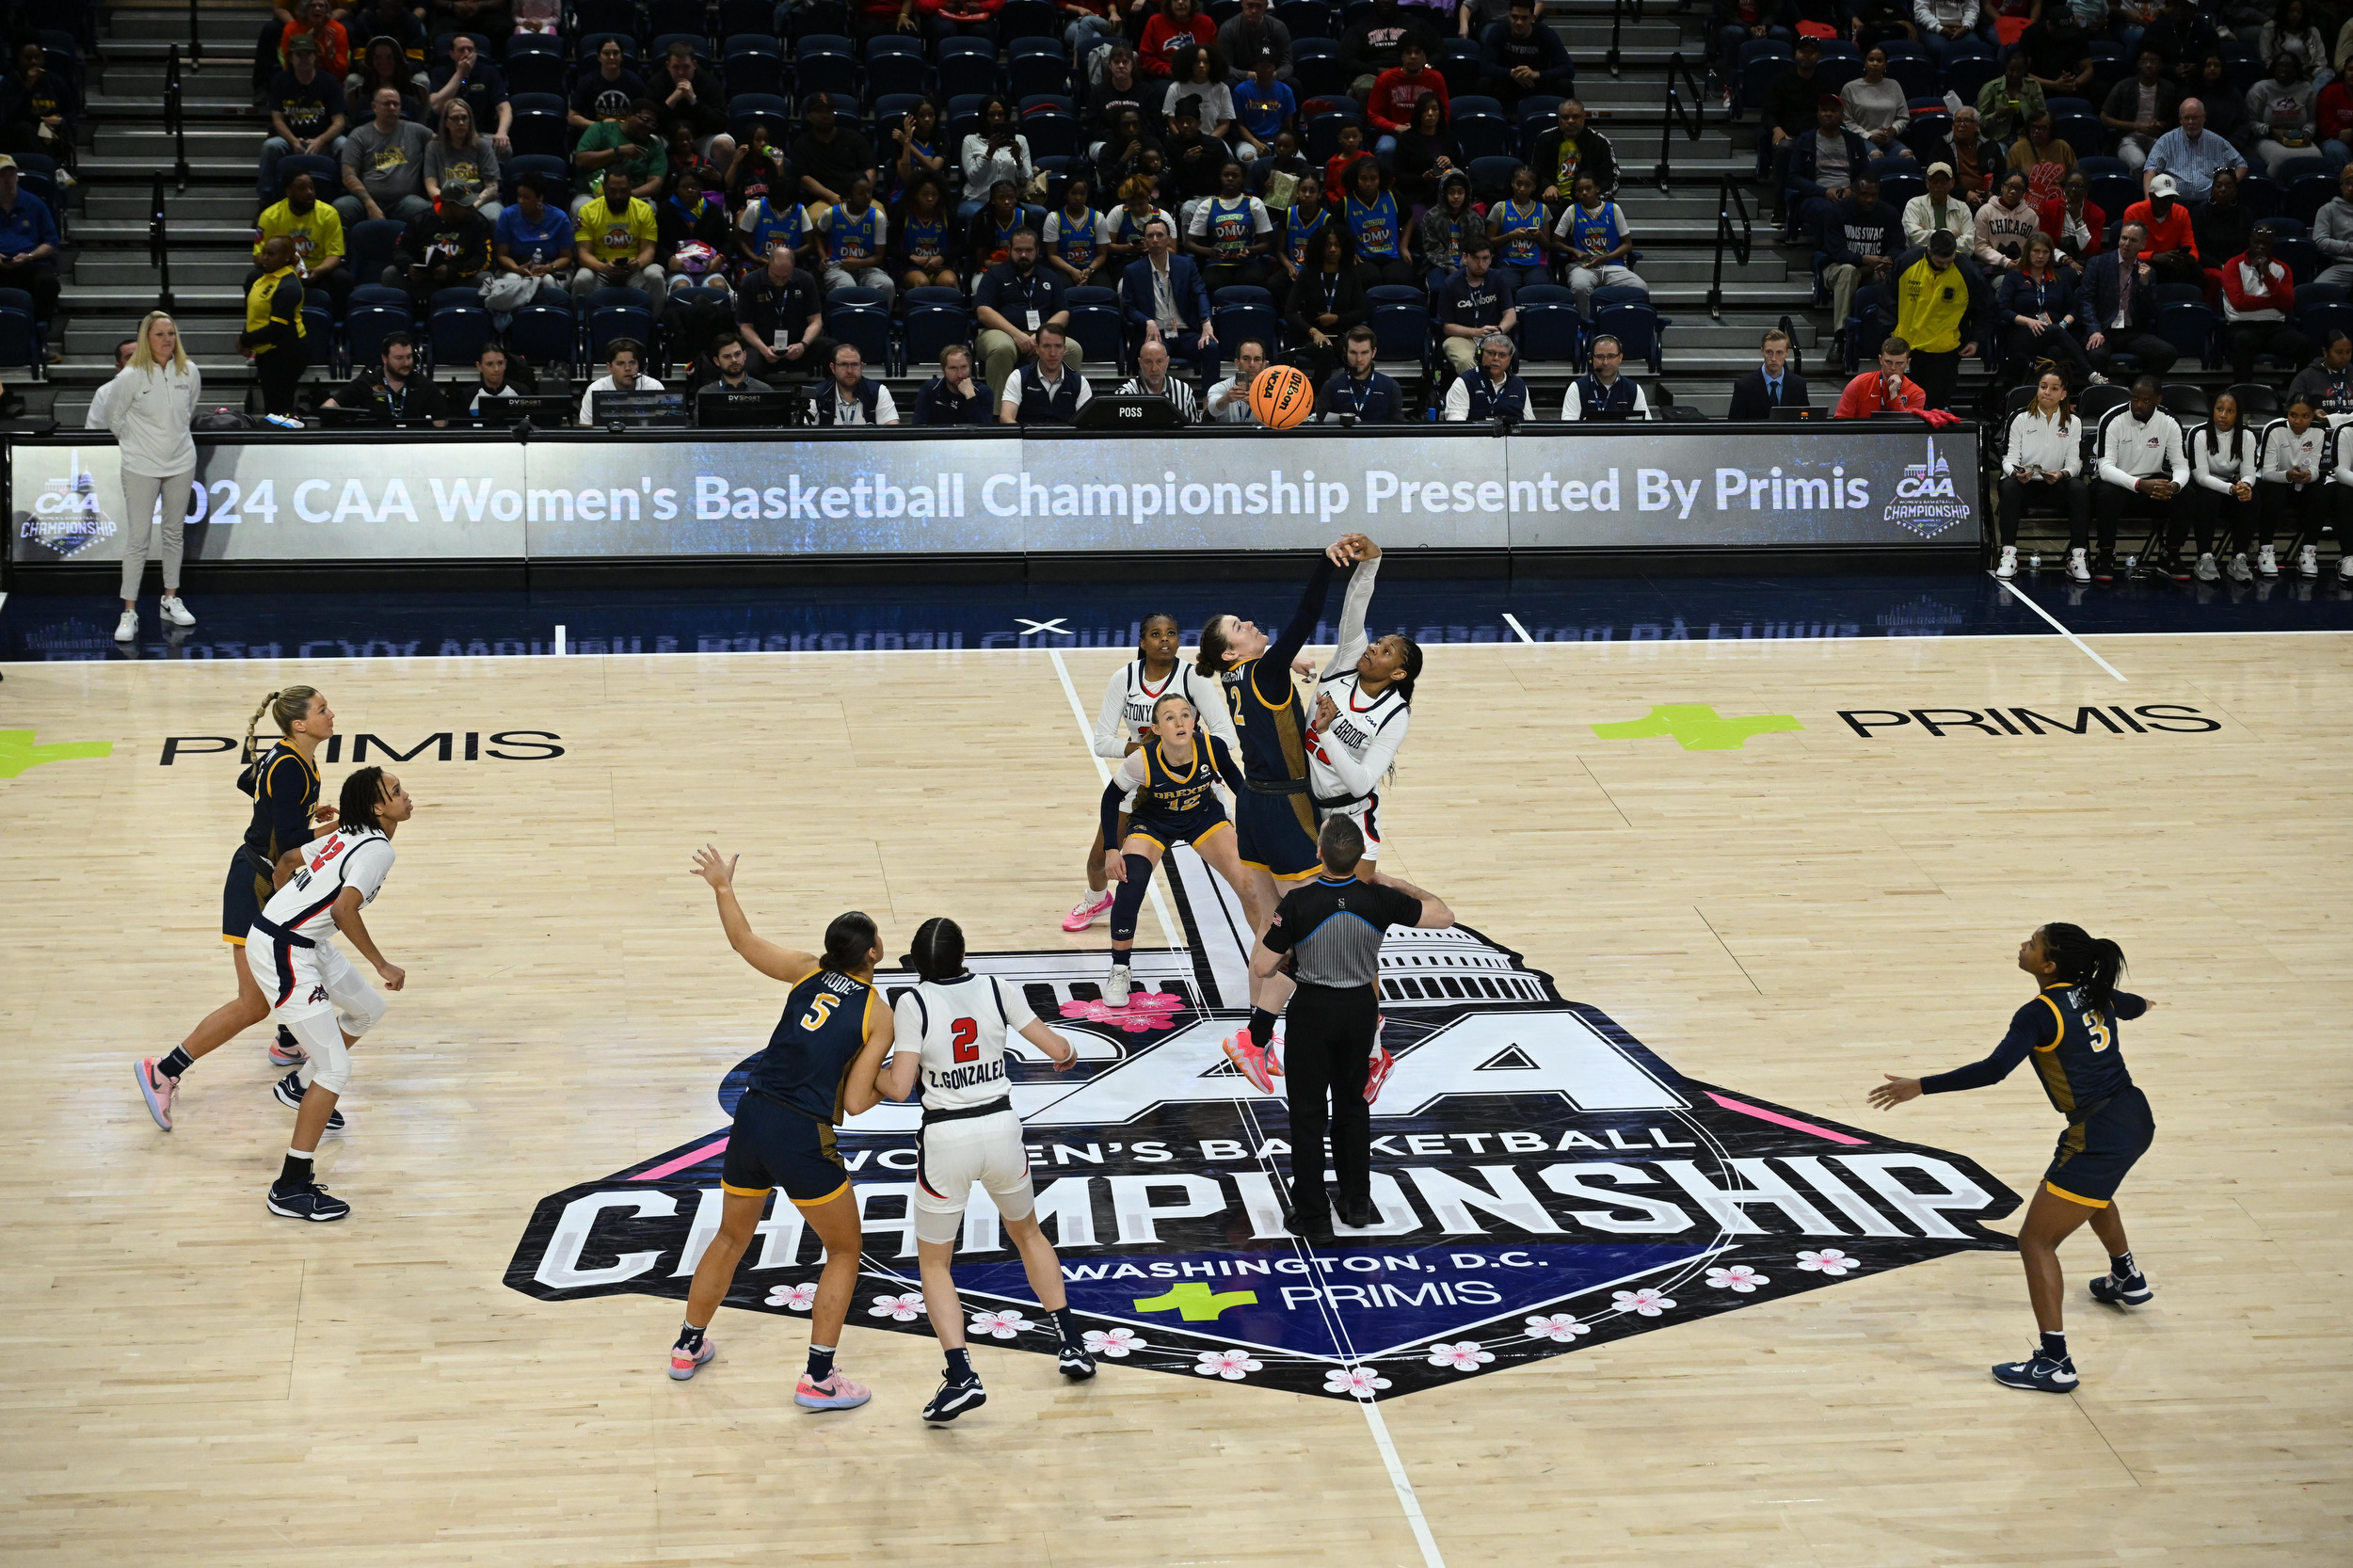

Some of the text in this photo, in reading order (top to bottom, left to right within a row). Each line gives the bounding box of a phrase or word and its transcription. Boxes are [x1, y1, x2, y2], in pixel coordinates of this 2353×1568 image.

[1090, 226, 1096, 237] 3
[1215, 224, 1245, 239] DMV
[1362, 229, 1390, 243] DMV
[1989, 218, 2033, 239] CHICAGO
[295, 241, 314, 252] MV
[437, 243, 459, 256] MV
[604, 234, 633, 247] DMV
[1512, 239, 1535, 250] DMV
[1584, 237, 1608, 248] DMV
[840, 247, 863, 258] DMV
[1264, 370, 1281, 399] NCAA
[1279, 373, 1303, 410] Wilson
[1119, 407, 1143, 418] POSS
[292, 478, 416, 523] CAA
[427, 472, 678, 523] Women's
[696, 473, 965, 521] Basketball
[981, 470, 1351, 524] Championship
[1367, 468, 1620, 515] Presented
[1638, 468, 1703, 520] By
[1716, 466, 1870, 511] Primis
[1896, 477, 1956, 498] CAA
[35, 492, 101, 514] CAA
[1883, 504, 1971, 521] CHAMPIONSHIP
[21, 520, 118, 538] CHAMPIONSHIP
[1125, 702, 1152, 723] STONY
[1365, 715, 1378, 728] CAA
[1836, 705, 2222, 738] PRIMIS
[1334, 718, 1369, 750] BROOK
[1165, 794, 1201, 811] 12
[311, 834, 345, 873] 22
[800, 991, 841, 1032] 5
[952, 1016, 980, 1064] 2
[2082, 1009, 2111, 1053] 3
[929, 1059, 1005, 1090] Z.GONZALEZ
[840, 1128, 1697, 1173] WOEN'S BAKETBALL
[1062, 1250, 1549, 1281] WASHINGTON, D.C.
[1280, 1280, 1503, 1311] PRIMIS
